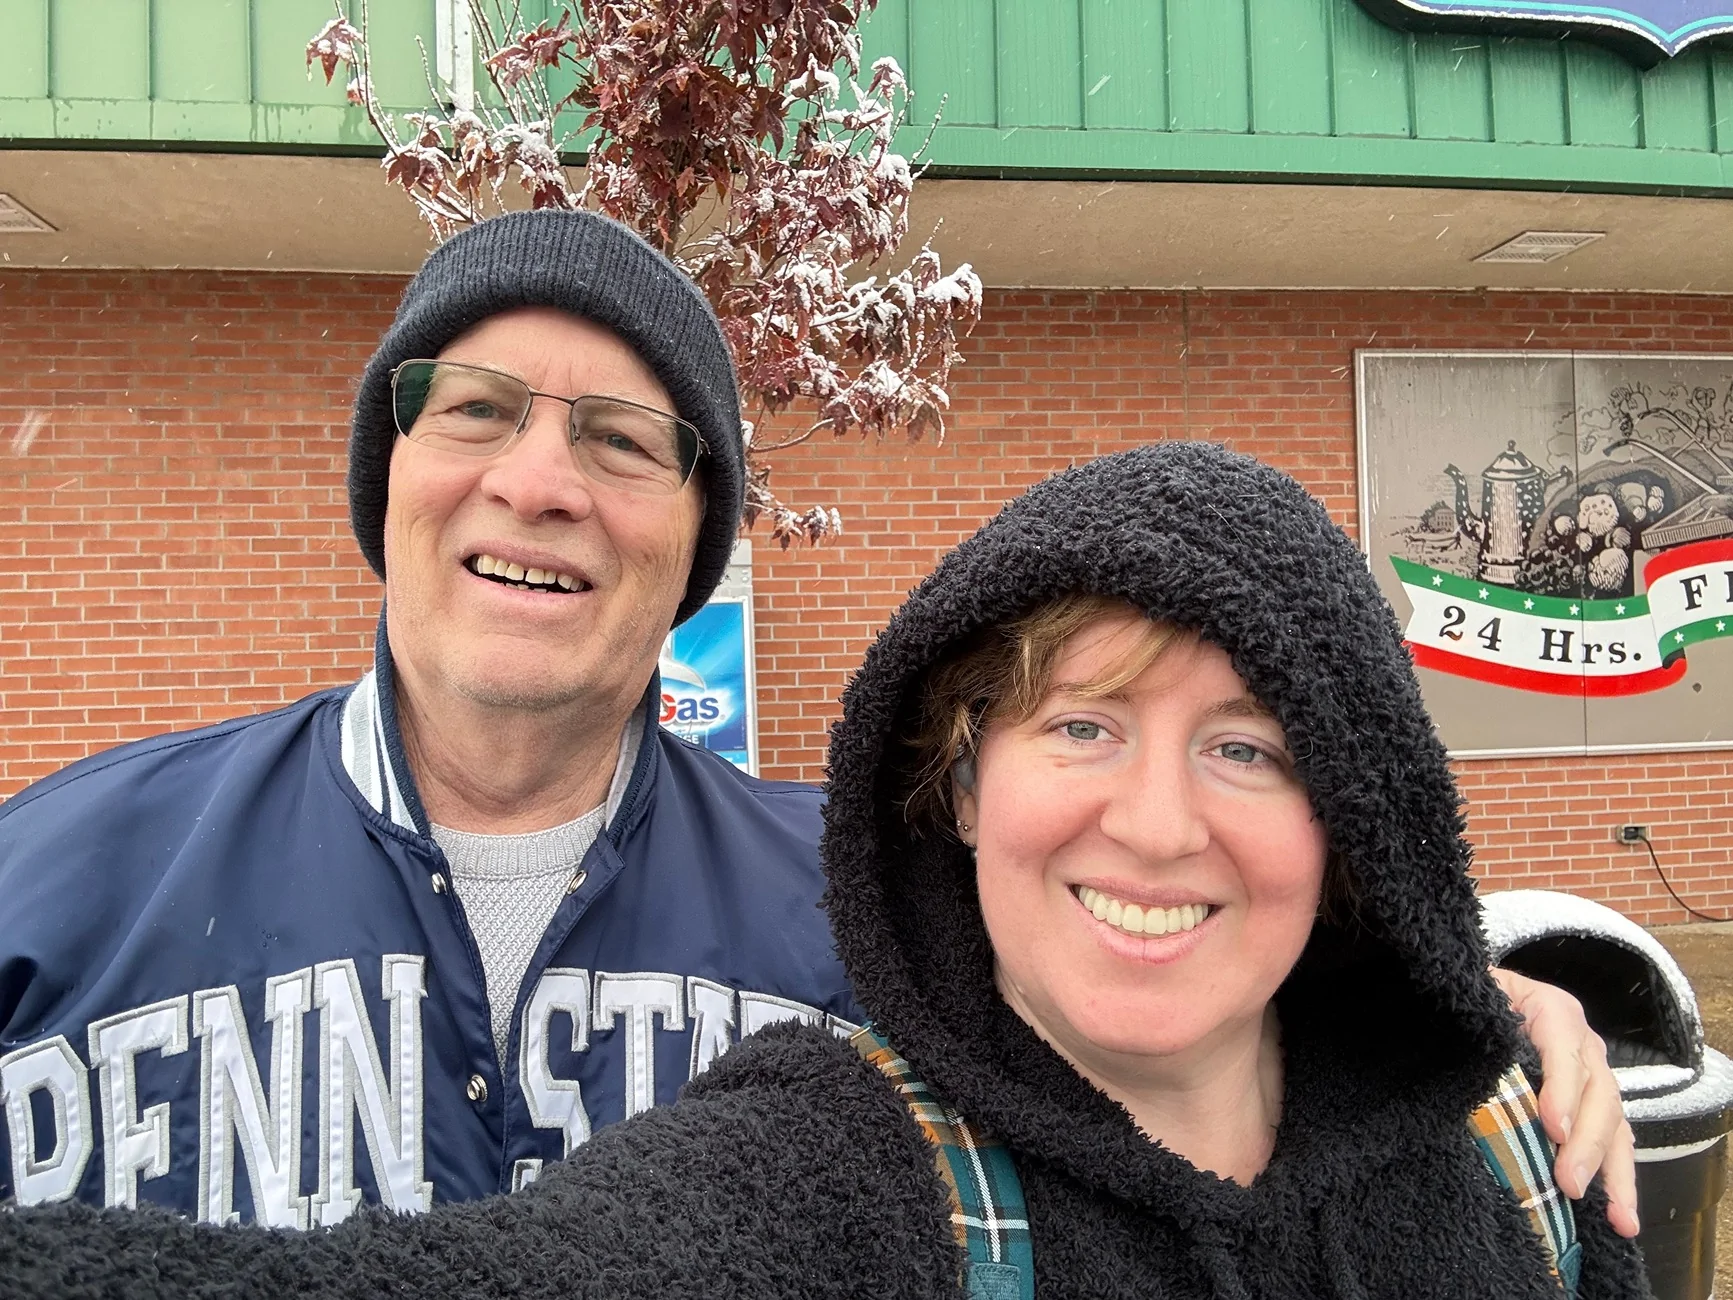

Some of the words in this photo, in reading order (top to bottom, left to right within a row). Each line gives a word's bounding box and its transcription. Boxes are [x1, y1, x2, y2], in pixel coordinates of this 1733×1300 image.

[1439, 606, 1502, 651] 24
[1539, 628, 1642, 664] Hrs.
[0, 953, 433, 1231] PENN
